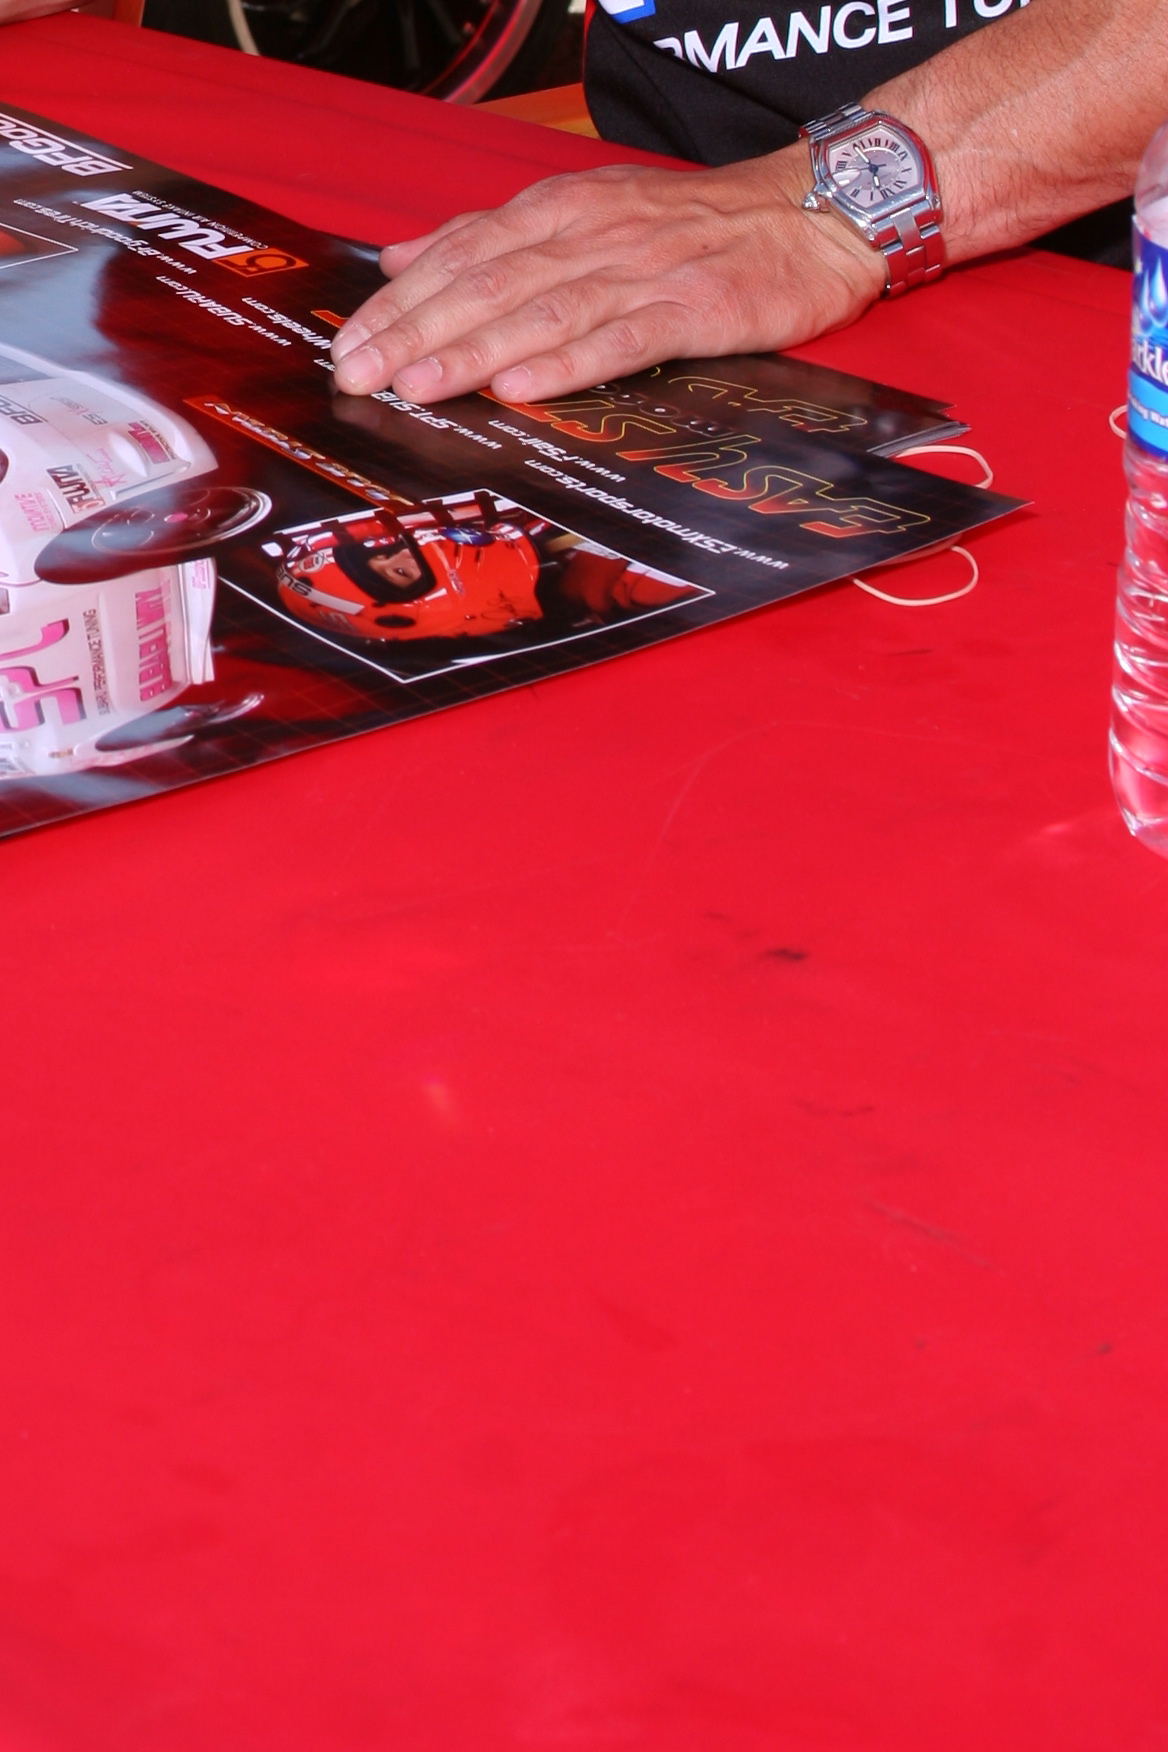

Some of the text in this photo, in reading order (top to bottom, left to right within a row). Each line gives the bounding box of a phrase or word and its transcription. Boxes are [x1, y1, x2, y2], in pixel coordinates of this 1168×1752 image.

[210, 218, 270, 250] COMPETITION
[155, 274, 292, 348] www.SUBARU.com
[523, 459, 790, 571] www.ESXmotorsports.com
